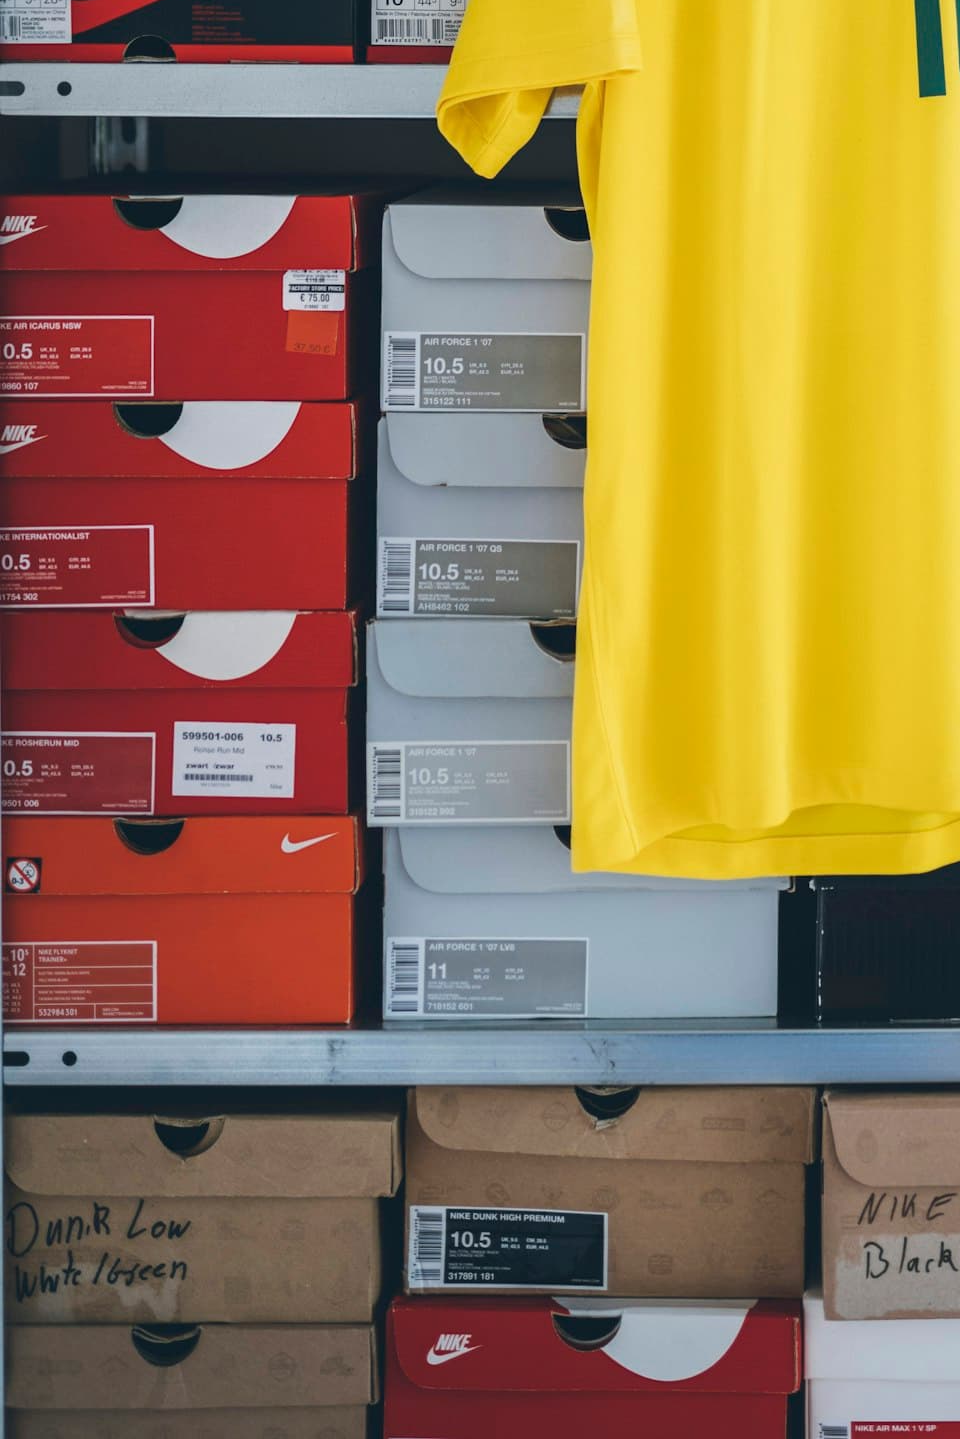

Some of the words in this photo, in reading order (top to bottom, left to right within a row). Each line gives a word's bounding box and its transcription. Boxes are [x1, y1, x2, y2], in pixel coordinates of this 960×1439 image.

[1, 216, 37, 232] NIKE
[308, 293, 330, 302] 75.00
[13, 322, 28, 330] AIR
[29, 322, 61, 330] ICARUS
[62, 322, 82, 330] NSW
[424, 338, 439, 346] AIR
[441, 338, 472, 346] FORCE
[423, 358, 464, 375] 10.5
[423, 397, 455, 406] 315122
[456, 397, 471, 406] 111
[1, 425, 37, 442] NIKE
[12, 532, 90, 541] INTERNATIONALIST
[418, 563, 459, 581] 10.5
[182, 731, 244, 741] 599501-006
[260, 733, 283, 742] 10.5
[15, 739, 61, 748] ROSHERUN
[63, 739, 80, 748] MID
[408, 768, 449, 785] 10.5
[12, 963, 26, 976] 12
[427, 963, 447, 980] 11
[127, 1199, 192, 1240] Low
[450, 1212, 471, 1220] NIKE
[472, 1213, 498, 1221] DUNK
[500, 1213, 522, 1222] HIGH
[523, 1214, 565, 1223] PREMIUM
[450, 1231, 492, 1248] 10.5
[448, 1272, 478, 1281] 317891
[480, 1272, 495, 1281] 181
[435, 1333, 472, 1352] NIKE
[855, 1424, 875, 1432] NIKE
[876, 1424, 890, 1432] AIR
[891, 1424, 910, 1432] MAX
[925, 1424, 937, 1432] SP
